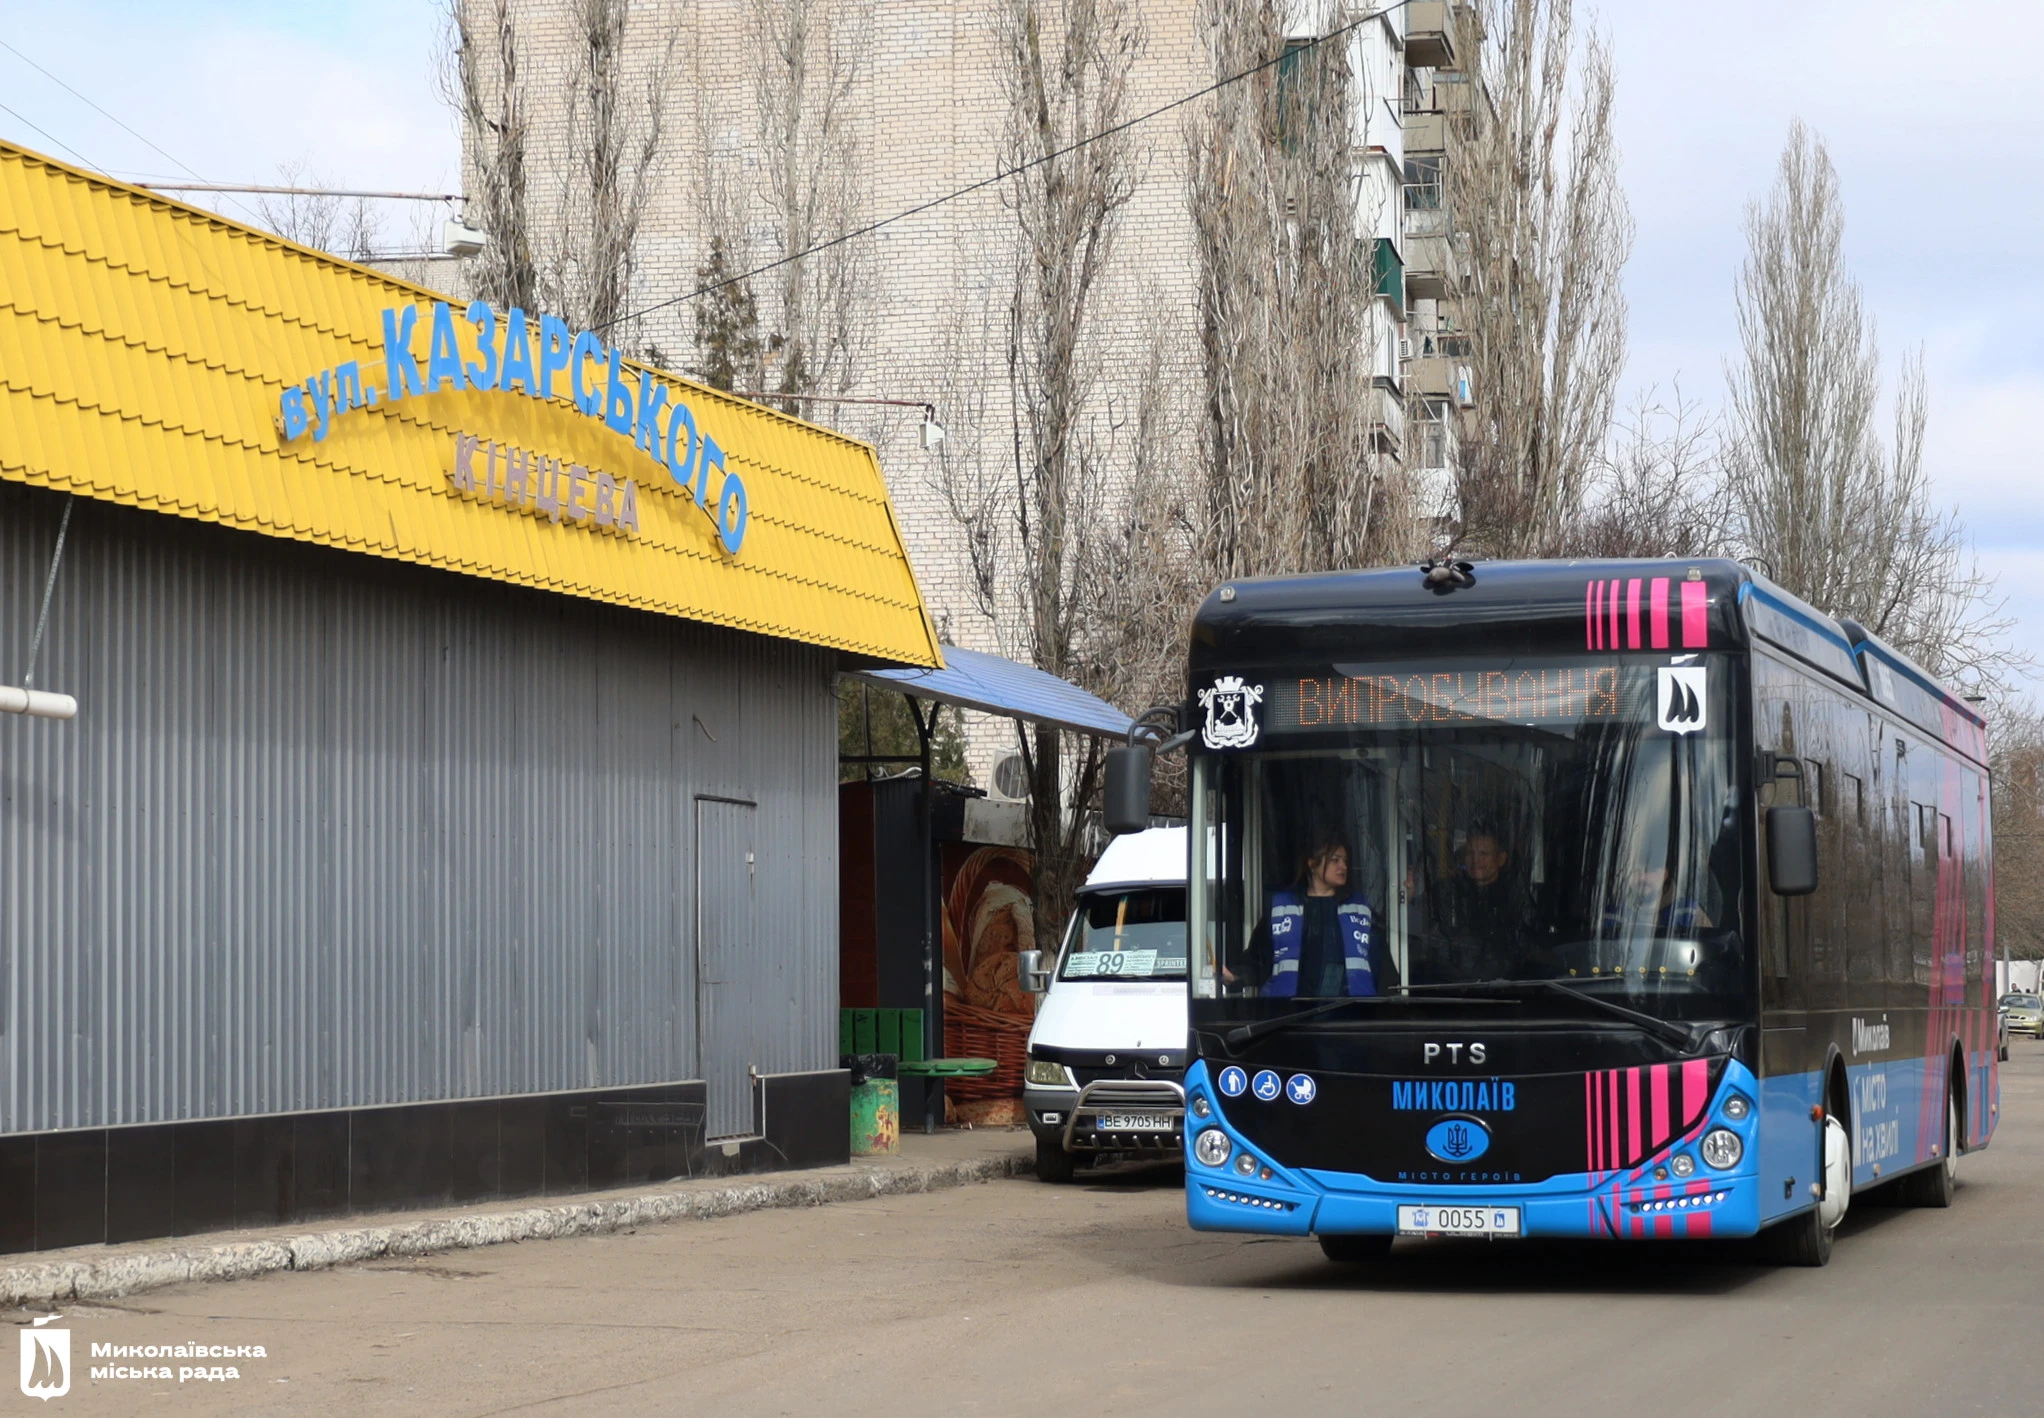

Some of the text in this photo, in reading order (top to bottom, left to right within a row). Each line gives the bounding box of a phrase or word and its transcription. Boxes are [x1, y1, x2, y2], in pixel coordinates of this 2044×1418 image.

[279, 300, 748, 555] вул. КАЗАРСЬКОГО
[454, 432, 640, 532] КІНЦЕВА
[1299, 667, 1618, 726] ВИПРОБУВАННЯ
[1096, 953, 1125, 975] 89
[1423, 1042, 1487, 1065] PTS
[1392, 1076, 1515, 1111] МИКОЛАЇВ
[1105, 1116, 1121, 1127] BE
[1124, 1116, 1151, 1127] 9705
[1398, 1170, 1521, 1181] МІСТО ГЕРОЇВ
[1438, 1209, 1485, 1229] 0055
